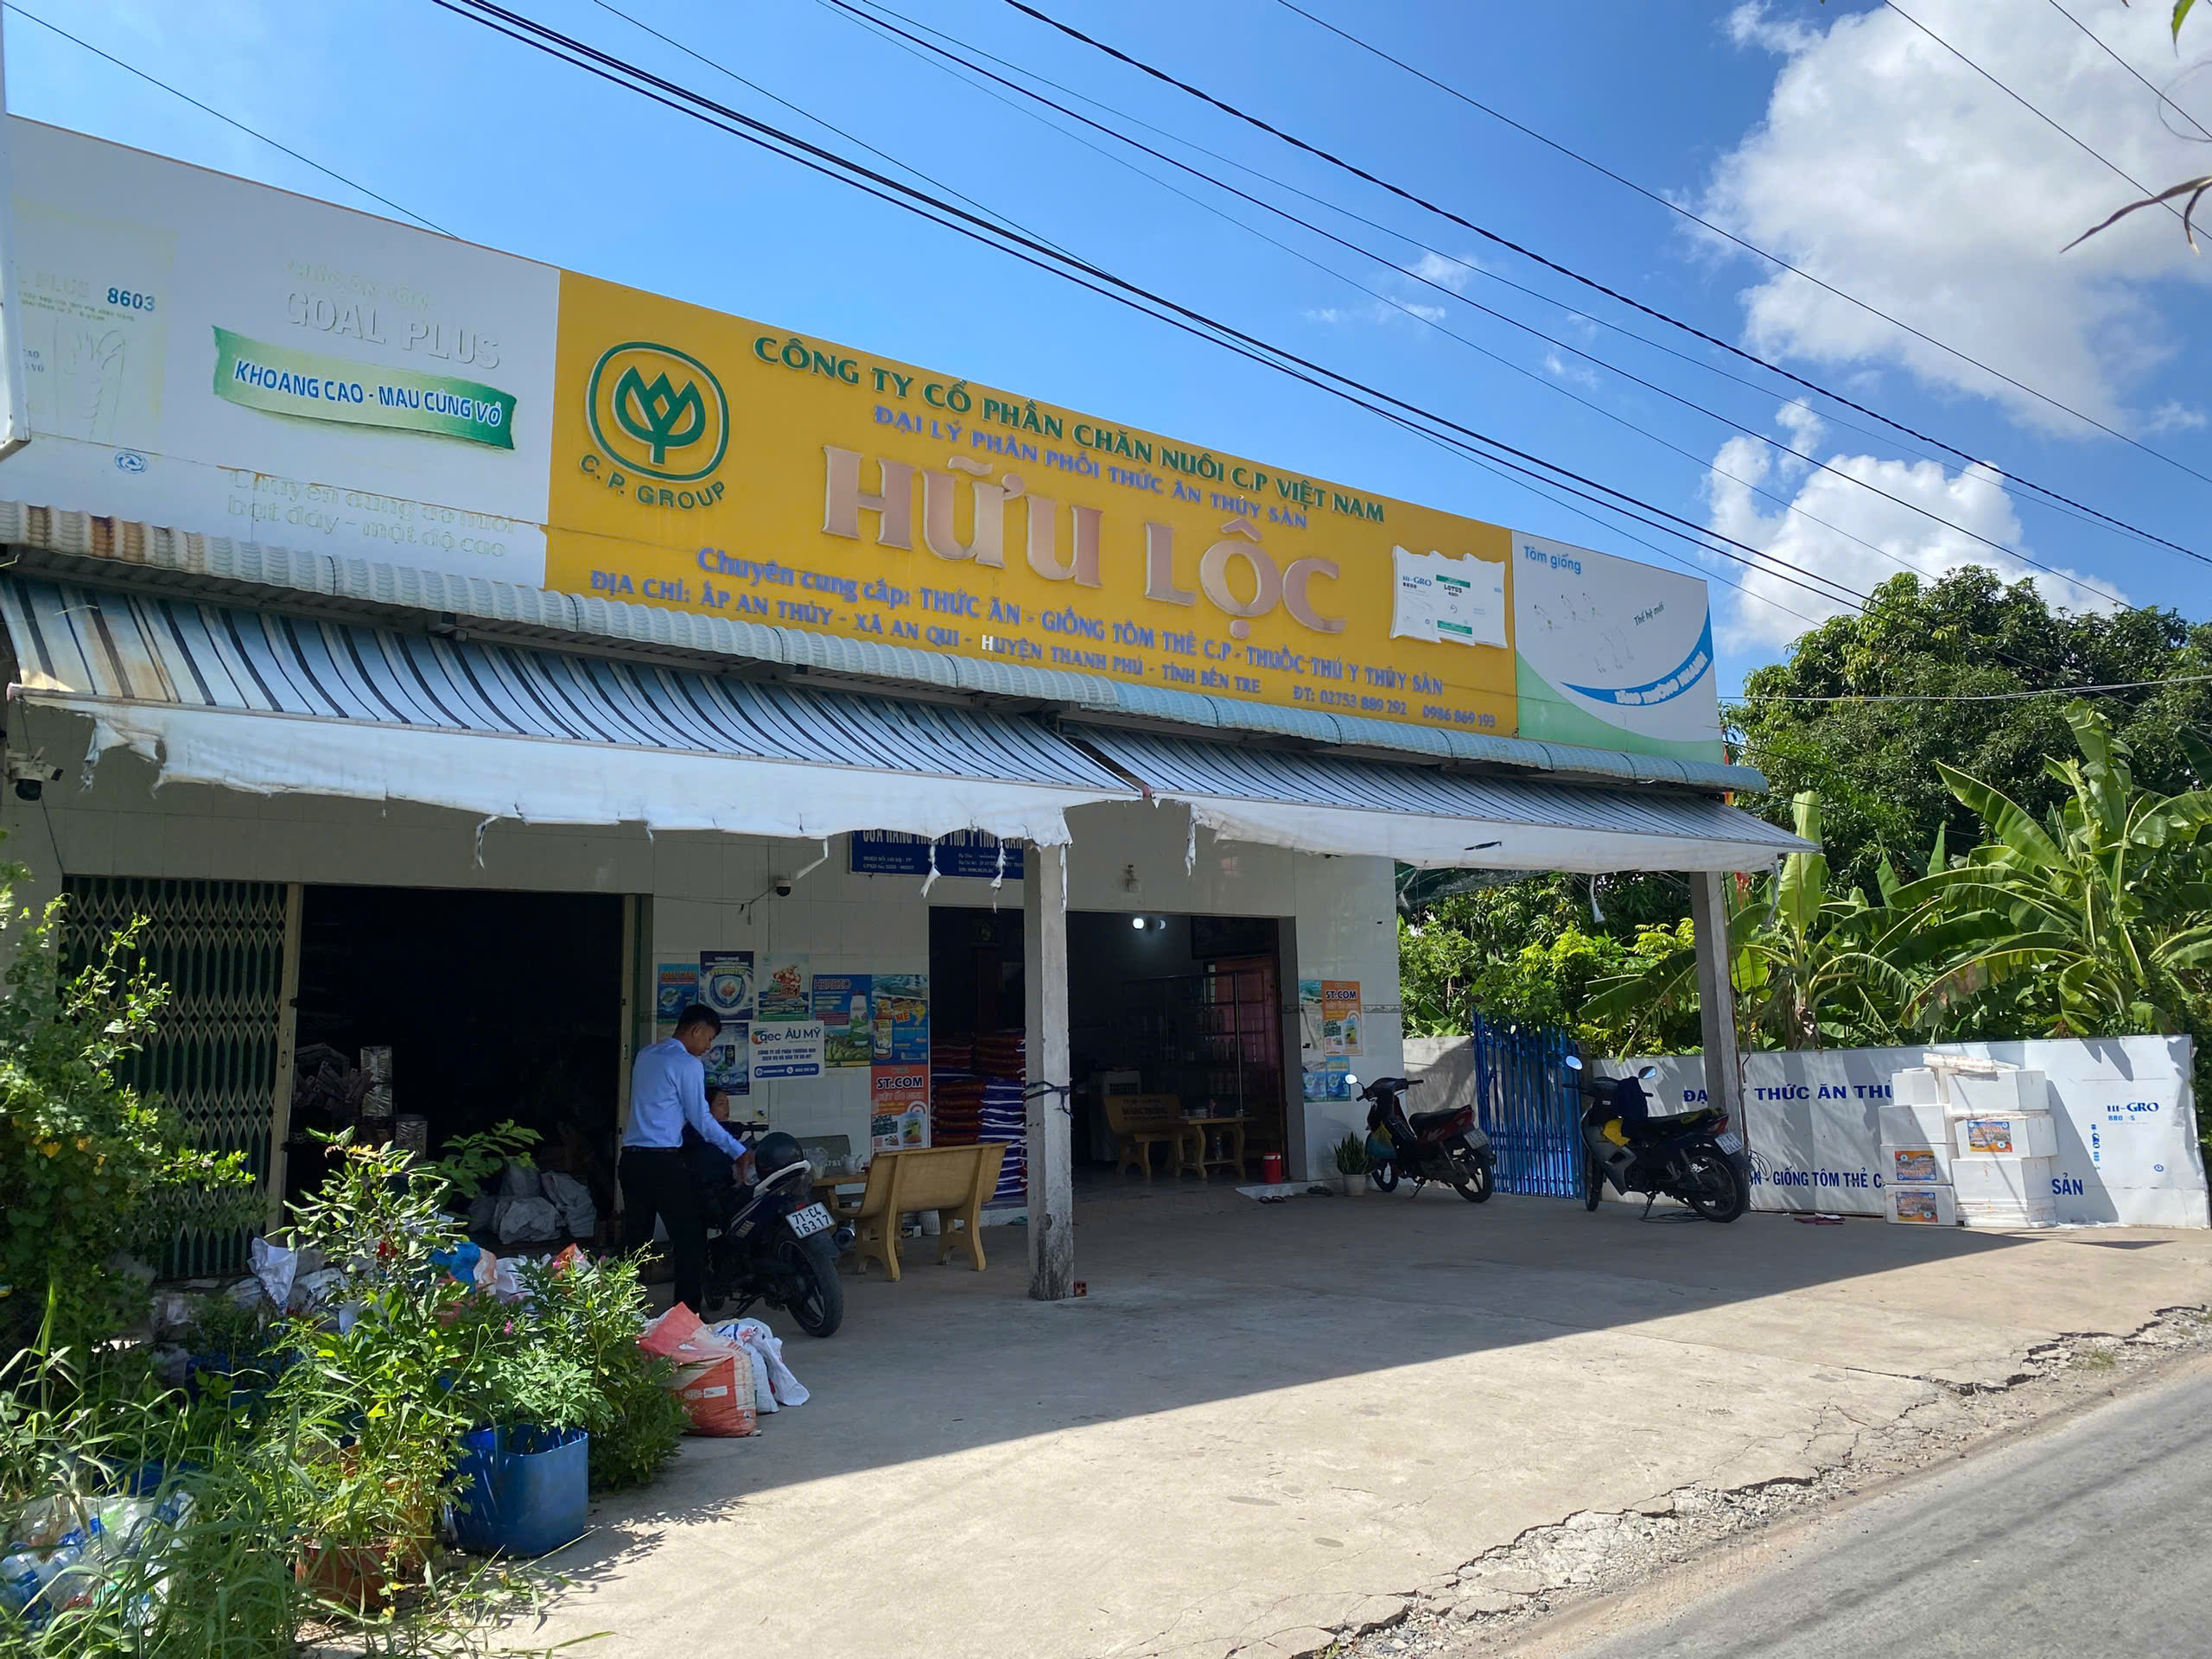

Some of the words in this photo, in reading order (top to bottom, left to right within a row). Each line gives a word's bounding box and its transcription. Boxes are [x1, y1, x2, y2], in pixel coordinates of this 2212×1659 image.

[106, 286, 156, 313] 8603
[286, 290, 387, 346] GOAL
[400, 316, 501, 371] PLUS
[324, 380, 364, 404] CAO
[378, 385, 420, 410] MAU
[475, 401, 502, 426] VỎ
[753, 336, 860, 385] CÔNG
[870, 366, 914, 399] TY
[922, 378, 972, 415] CỔ
[982, 397, 1065, 440] PHẦN
[1071, 423, 1153, 464] CHĂN
[1160, 445, 1225, 483] NUÔI
[1230, 467, 1268, 493] C.P
[1274, 477, 1326, 512] VIỆT
[1332, 492, 1385, 524] NAM
[873, 404, 923, 435] ĐẠI
[930, 418, 963, 443] LÝ
[970, 429, 1038, 463] PHÂN
[1044, 447, 1100, 480] PHỐI
[1107, 464, 1165, 495] THỨC
[1172, 480, 1203, 506] ĂN
[1210, 492, 1261, 519] THỦY
[1268, 505, 1307, 531] SẢN
[635, 480, 727, 512] GROUP
[1523, 544, 1548, 561] Tôm
[1550, 552, 1583, 575] giống
[1144, 516, 1348, 640] LỘC
[590, 569, 635, 596] ĐỊA
[735, 594, 768, 616] AN
[891, 619, 920, 640] AN
[925, 625, 959, 647] QUI
[981, 634, 1043, 662] HUYỆN
[1050, 645, 1108, 671] THANH
[1112, 654, 1144, 676] PHÚ
[1199, 666, 1230, 690] BẾN
[1234, 676, 1262, 694] TRE
[696, 546, 795, 588] Chuyên
[800, 570, 858, 603] cung
[862, 577, 912, 610] cấp:
[918, 586, 982, 619] THỨC
[987, 595, 1021, 626] ĂN
[1039, 603, 1106, 642] GIỐNG
[1112, 620, 1155, 649] TÔM
[1160, 629, 1198, 657] THẺ
[1202, 639, 1232, 662] C.P
[1347, 663, 1359, 683] Y
[1364, 664, 1408, 691] THỦY
[1411, 671, 1444, 696] SẢN
[1292, 685, 1315, 703] ĐT:
[1386, 698, 1408, 715] 292
[1422, 703, 1452, 722] 0986
[1453, 709, 1476, 725] 869
[1477, 712, 1497, 728] 193
[1325, 989, 1357, 1001] ST.COM
[785, 1027, 801, 1039] ÂU
[803, 1026, 821, 1039] MỸ
[876, 1076, 924, 1090] ST.COM
[1754, 1083, 1810, 1102] THỨC
[1816, 1083, 1847, 1100] ĂN
[1772, 1166, 1809, 1187] GIỐNG
[1811, 1167, 1840, 1187] TÔM
[1846, 1166, 1868, 1188] THẺ
[2051, 1172, 2084, 1196] SẢN
[791, 1206, 822, 1224] 71-C4
